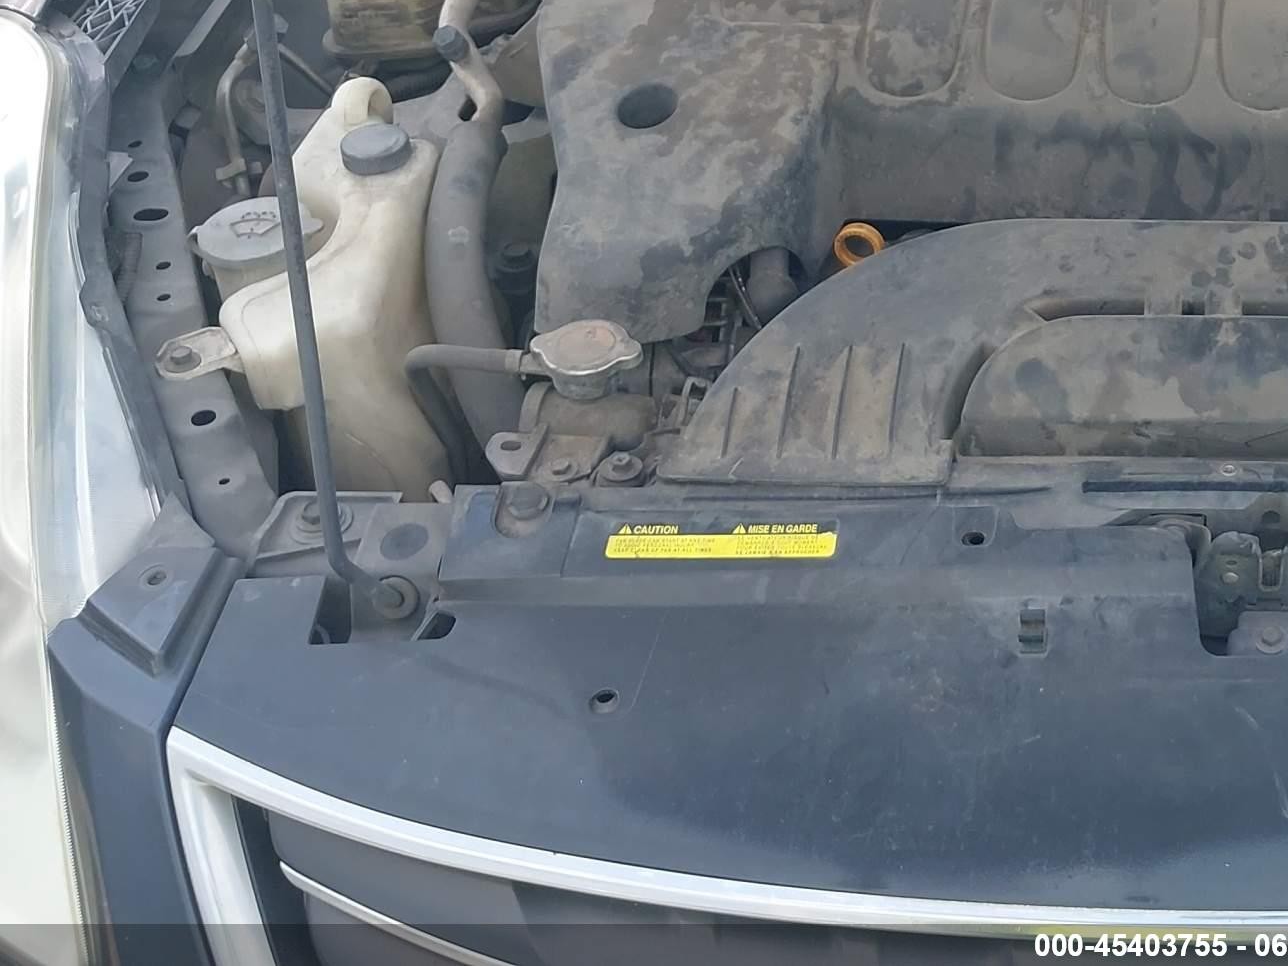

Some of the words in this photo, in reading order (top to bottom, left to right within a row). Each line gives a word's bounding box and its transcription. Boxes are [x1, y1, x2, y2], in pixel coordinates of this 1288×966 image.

[633, 525, 680, 535] CAUTION
[747, 524, 770, 534] MISE
[771, 524, 785, 534] EN
[785, 523, 818, 533] GARDE
